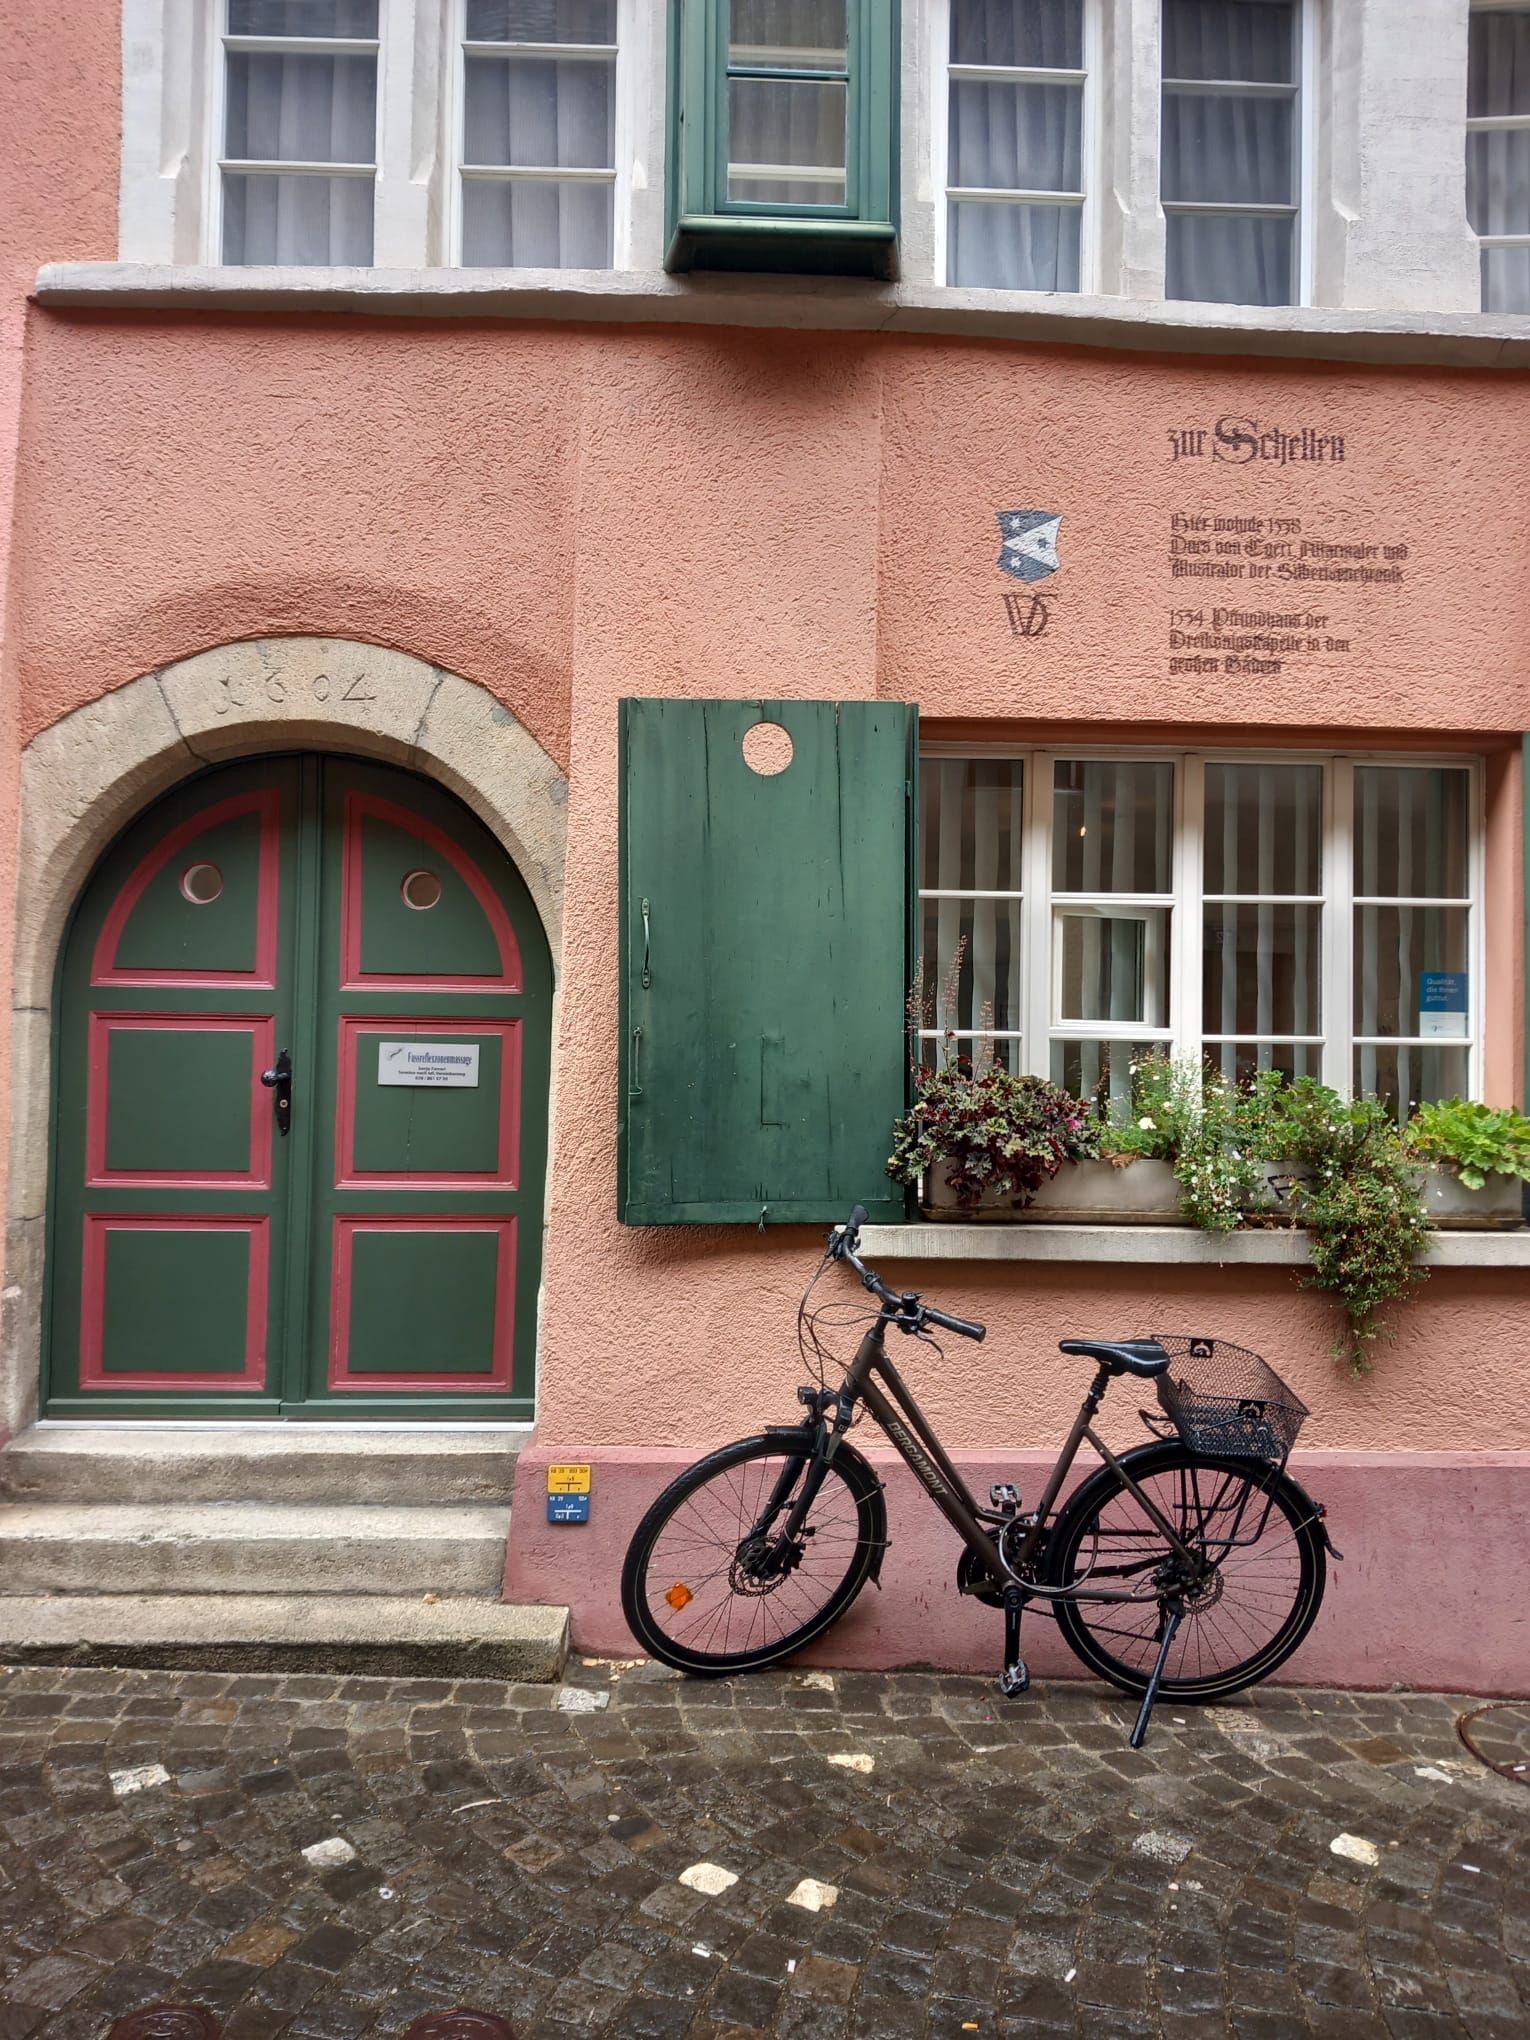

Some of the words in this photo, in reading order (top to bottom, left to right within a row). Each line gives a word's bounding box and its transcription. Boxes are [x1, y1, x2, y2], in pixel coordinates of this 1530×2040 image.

[1167, 428, 1208, 462] zur
[1212, 415, 1345, 467] Schellen
[1171, 512, 1210, 532] Hier
[1214, 516, 1263, 534] wohnte
[1216, 540, 1241, 555] von
[1248, 561, 1271, 578] der
[1304, 613, 1328, 630] der
[1306, 635, 1320, 651] in
[887, 1422, 948, 1495] BERGAMONT
